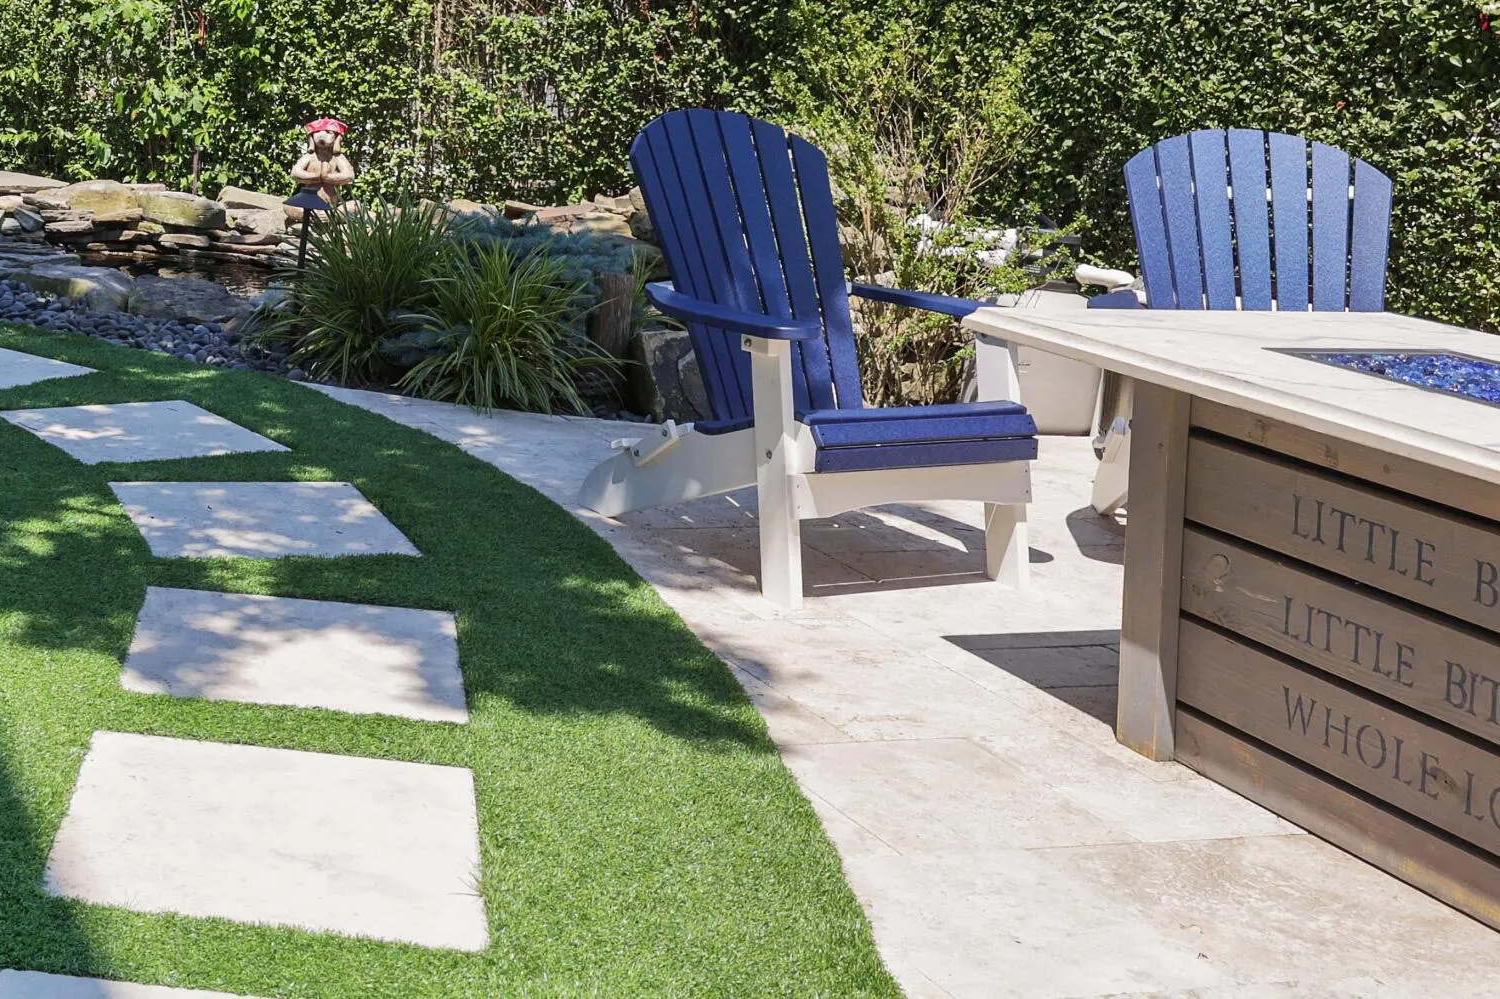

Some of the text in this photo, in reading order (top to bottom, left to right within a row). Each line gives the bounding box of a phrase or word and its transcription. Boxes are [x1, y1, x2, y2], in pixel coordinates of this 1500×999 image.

[1291, 493, 1436, 587] LITTLE
[1281, 595, 1416, 688] LITTLE
[1282, 685, 1440, 801] WHOLE
